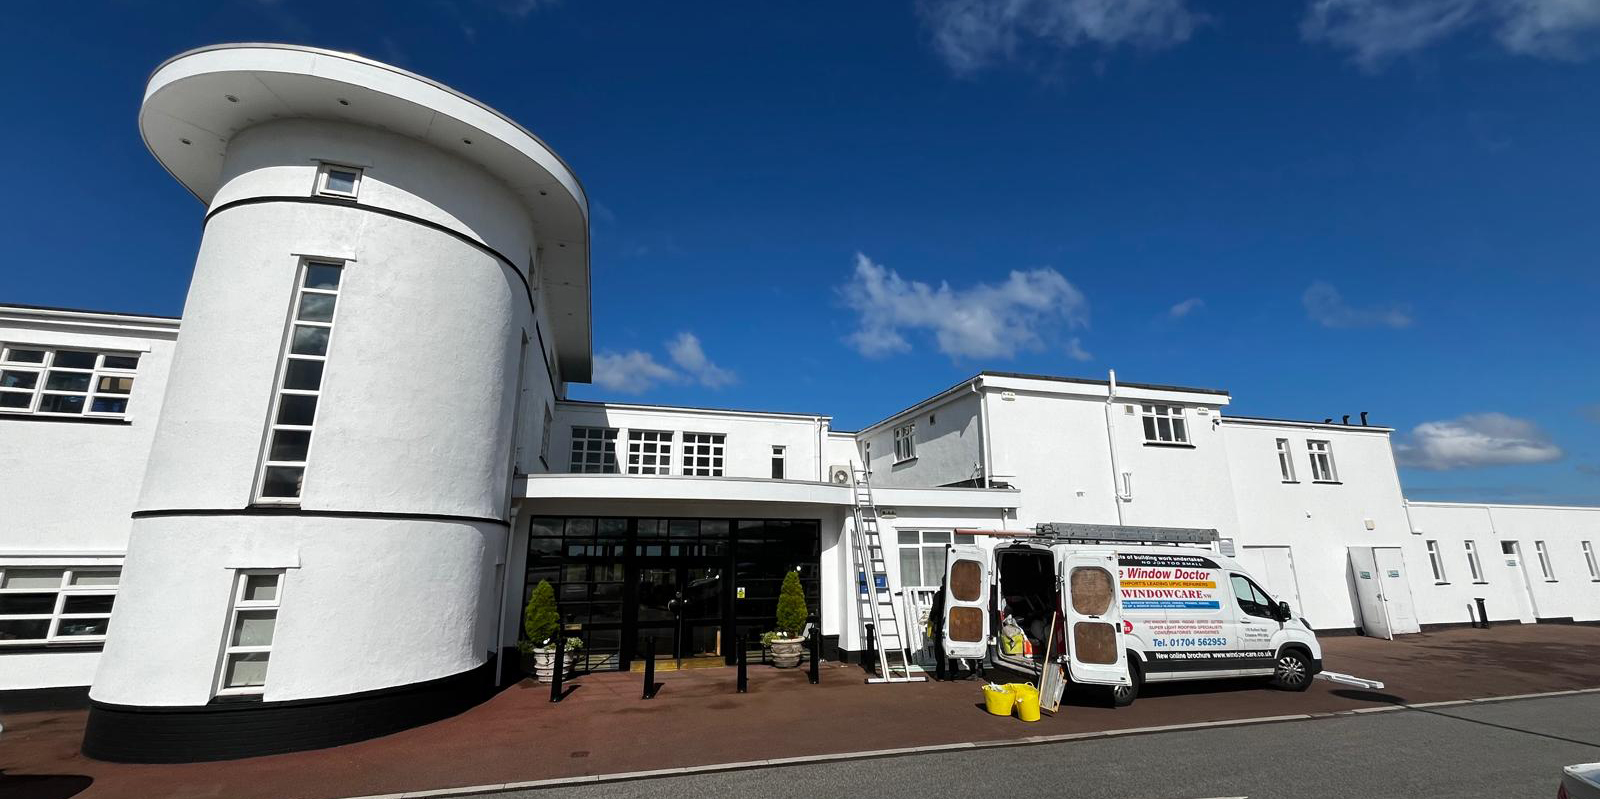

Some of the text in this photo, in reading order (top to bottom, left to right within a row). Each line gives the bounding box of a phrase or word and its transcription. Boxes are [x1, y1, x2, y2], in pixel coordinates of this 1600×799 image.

[1128, 568, 1171, 579] Window
[1175, 568, 1210, 580] Doctor
[1121, 589, 1203, 598] WINDOWCARE
